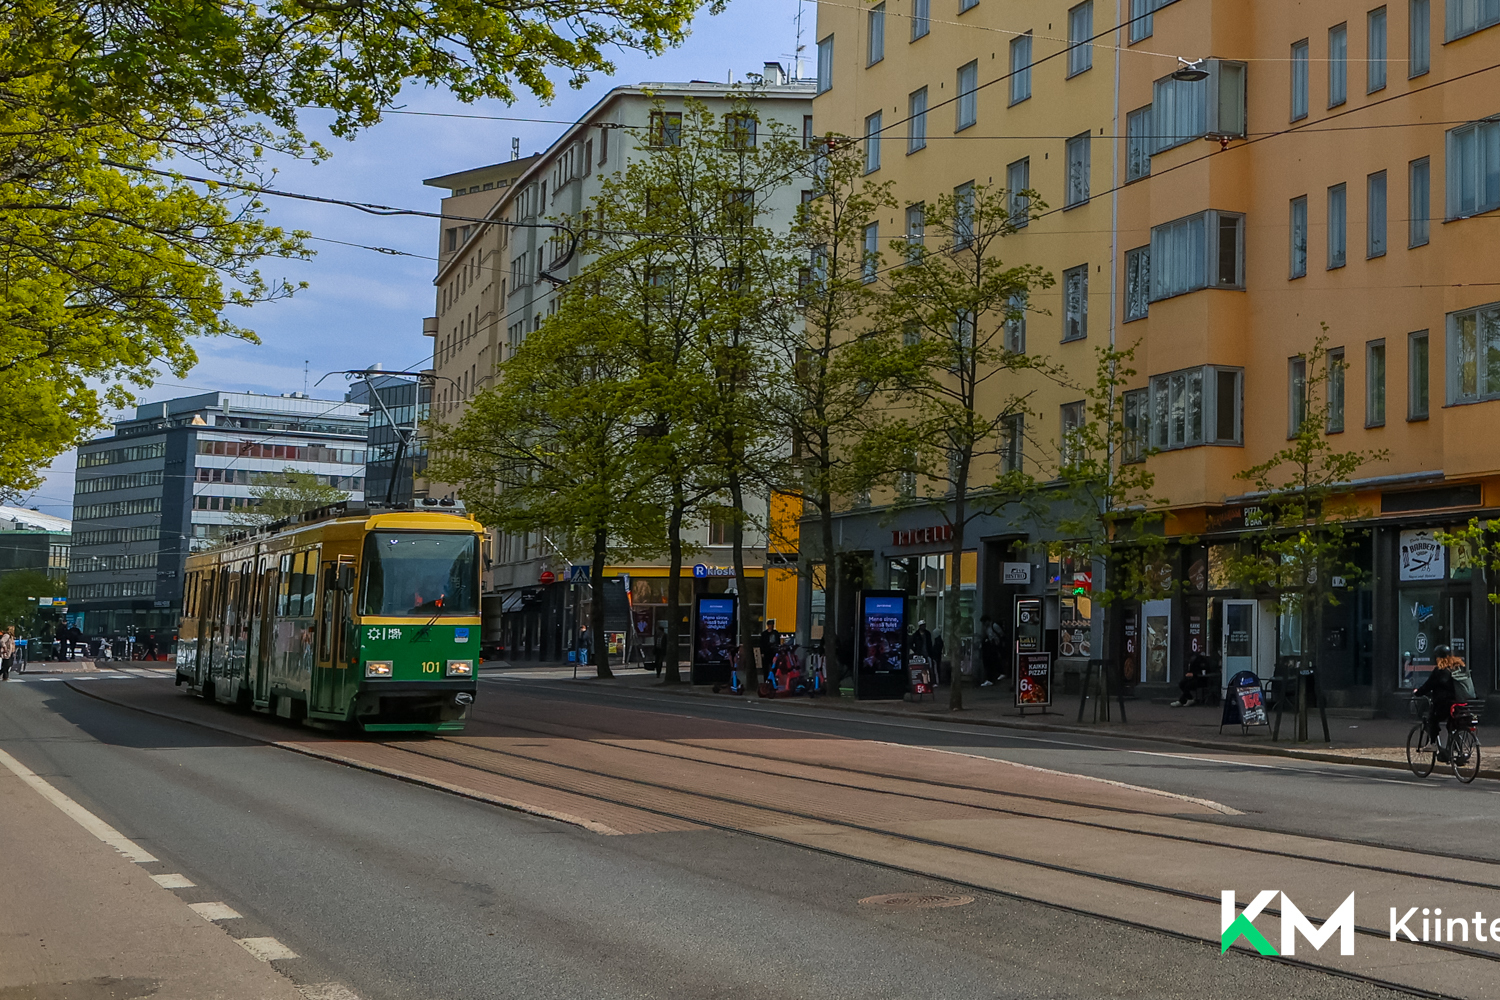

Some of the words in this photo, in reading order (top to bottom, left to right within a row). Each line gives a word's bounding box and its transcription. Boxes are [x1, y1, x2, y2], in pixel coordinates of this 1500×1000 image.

[892, 525, 955, 545] TRICELL
[1409, 542, 1435, 553] BARBER
[421, 661, 440, 673] 101
